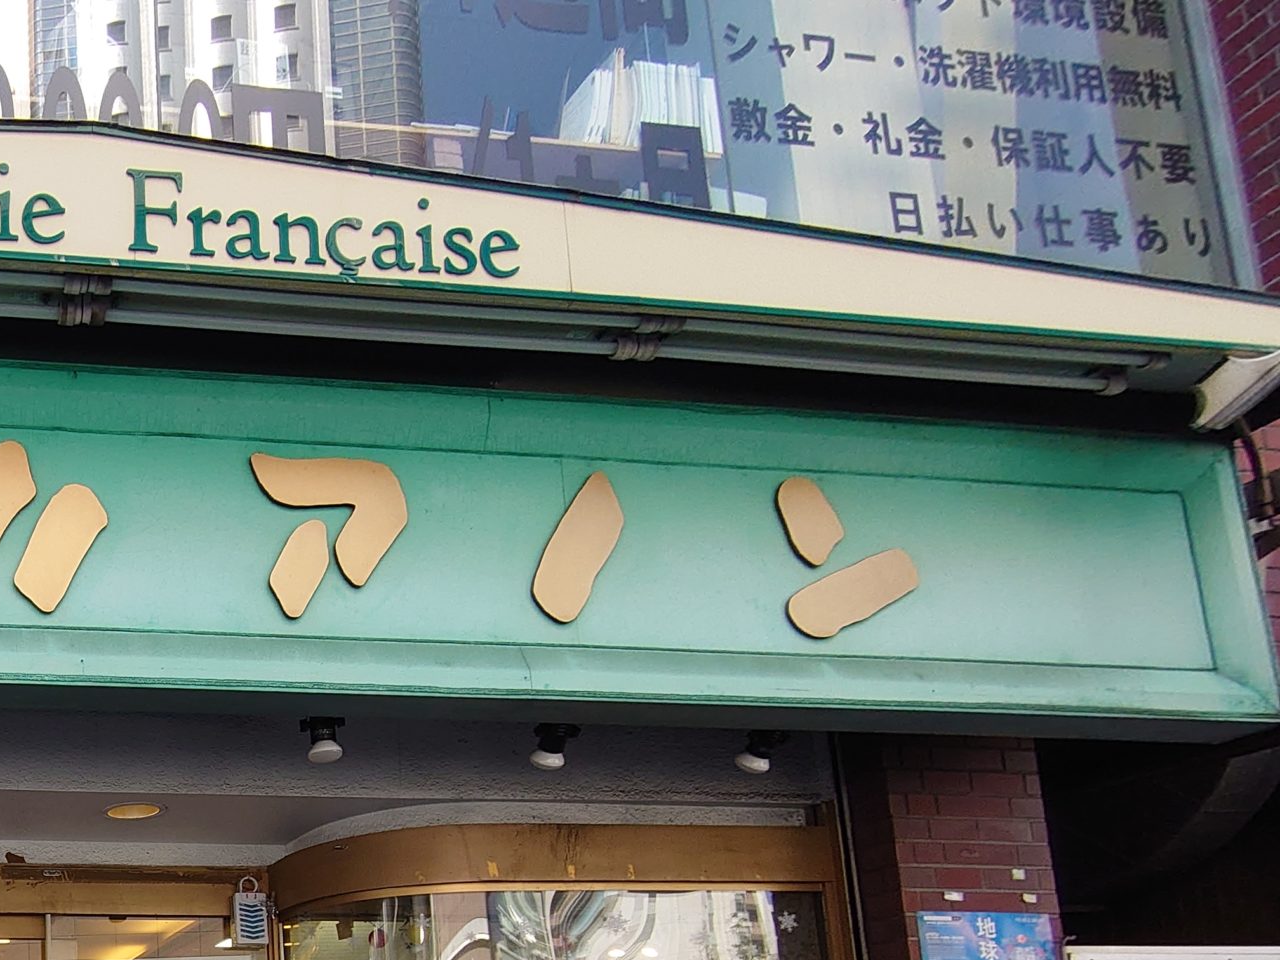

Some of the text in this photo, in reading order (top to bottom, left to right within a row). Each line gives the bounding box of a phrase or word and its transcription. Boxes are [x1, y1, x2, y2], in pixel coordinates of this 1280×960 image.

[125, 167, 521, 280] Française
[889, 191, 1212, 258] 日払い仕事あり
